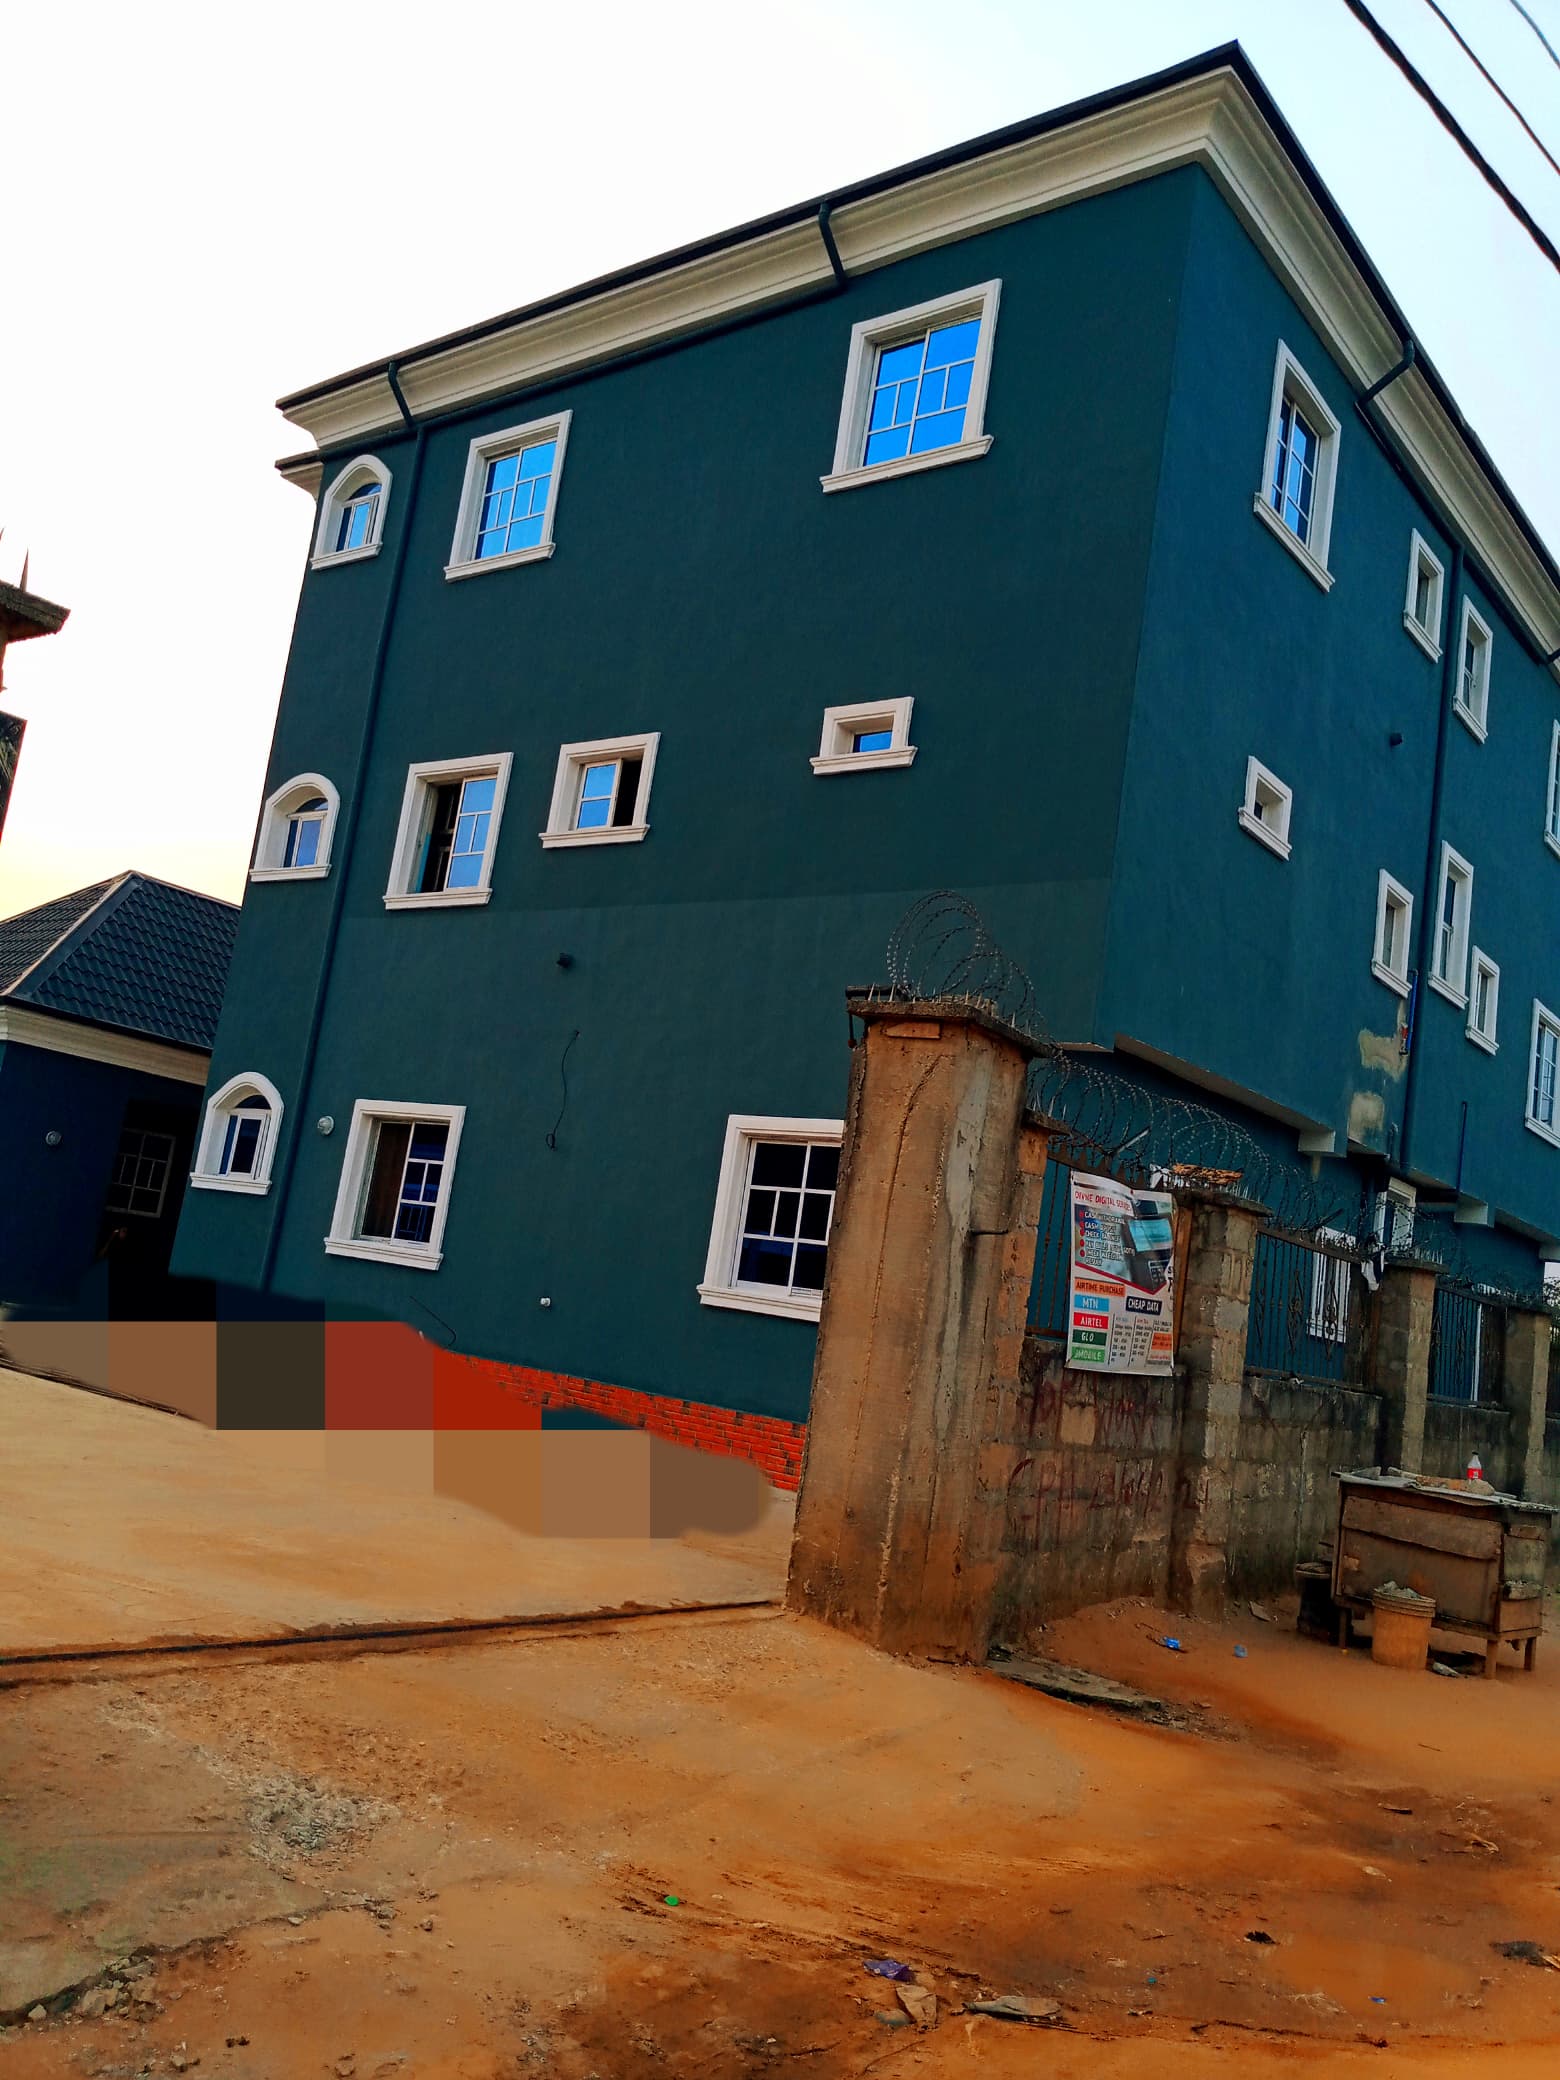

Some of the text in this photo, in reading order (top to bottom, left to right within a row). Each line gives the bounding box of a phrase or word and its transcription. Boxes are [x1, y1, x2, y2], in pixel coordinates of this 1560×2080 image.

[1095, 1195, 1115, 1206] DIGITAL
[1084, 1221, 1099, 1229] CASH
[1085, 1230, 1100, 1238] CHECK
[1075, 1281, 1124, 1295] AIRTIME PURCHASE
[1082, 1297, 1098, 1309] MTN
[1128, 1298, 1160, 1312] CHEAP DATA
[1080, 1317, 1103, 1328] AIRTEL
[1081, 1332, 1094, 1342] GLO
